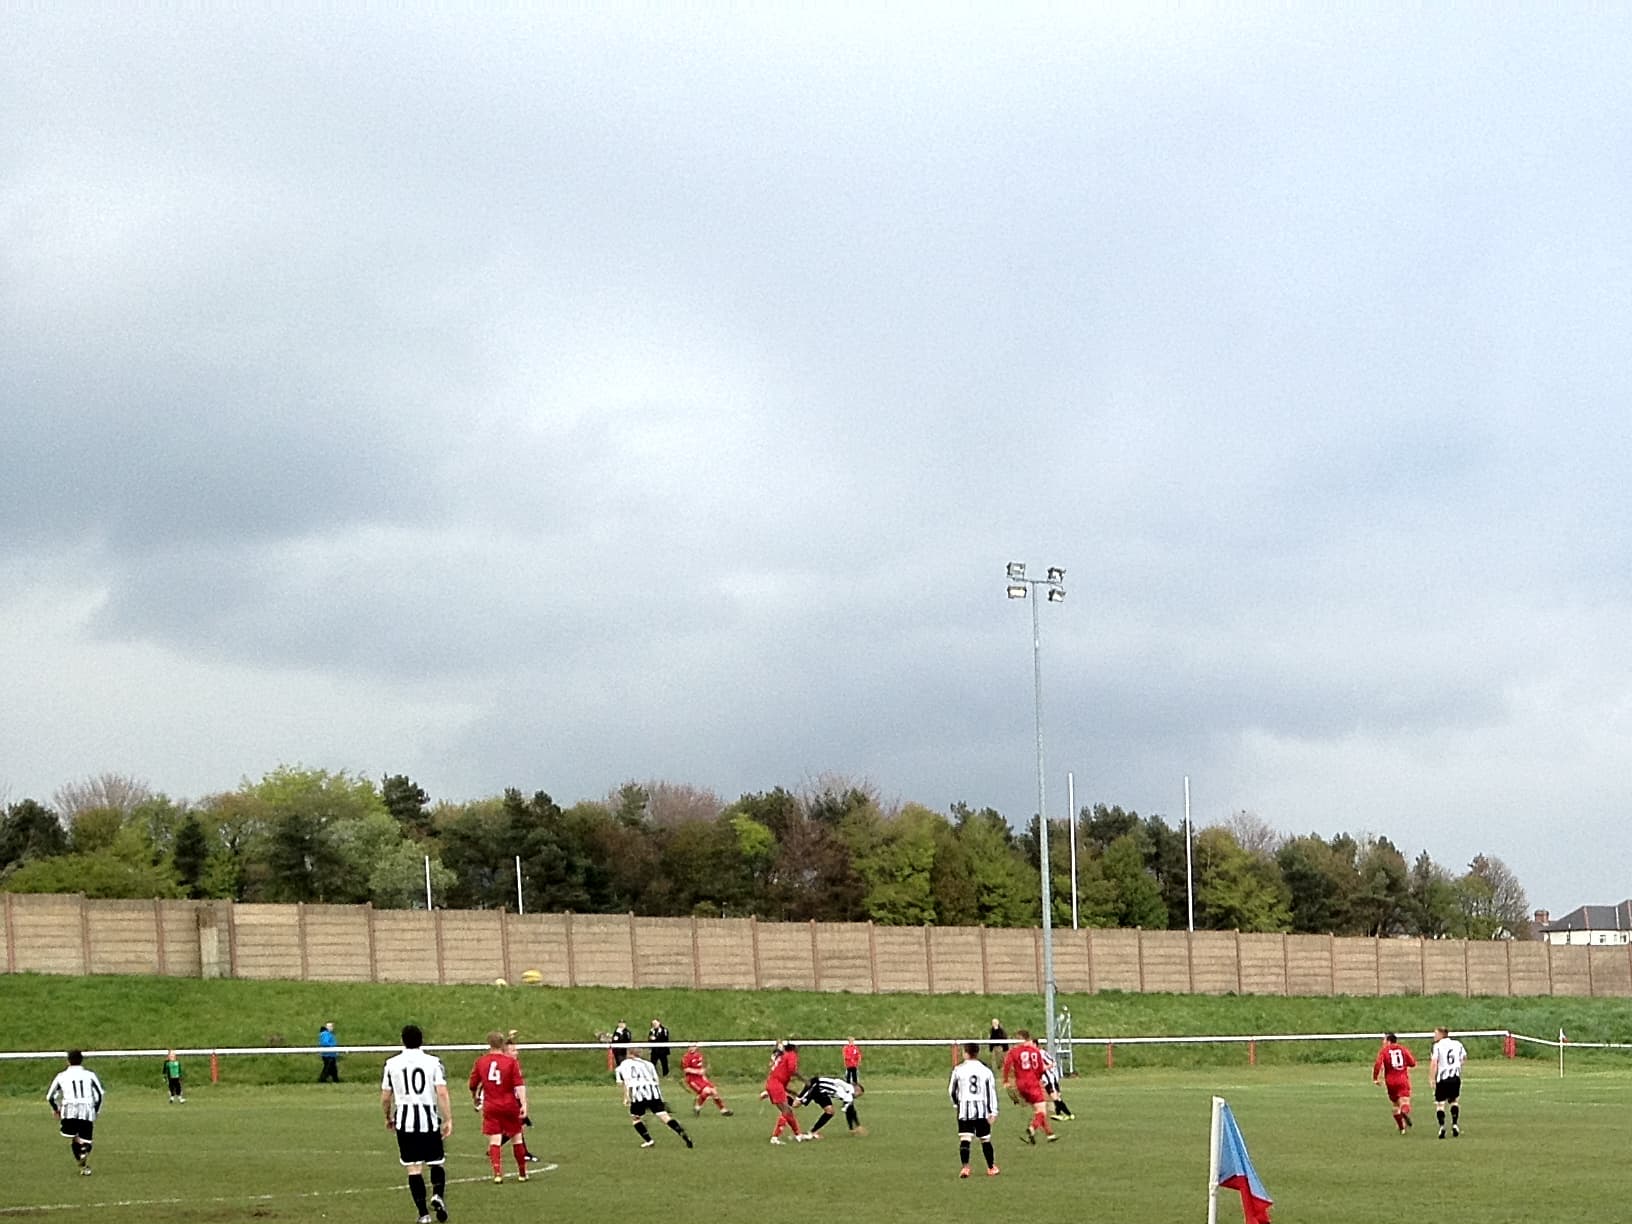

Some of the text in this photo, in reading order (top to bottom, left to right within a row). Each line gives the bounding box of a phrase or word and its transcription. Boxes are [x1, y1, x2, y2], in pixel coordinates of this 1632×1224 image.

[1446, 1048, 1455, 1065] 6
[402, 1067, 426, 1095] 10
[488, 1061, 502, 1085] 4
[72, 1080, 84, 1099] 11
[969, 1075, 978, 1094] 8
